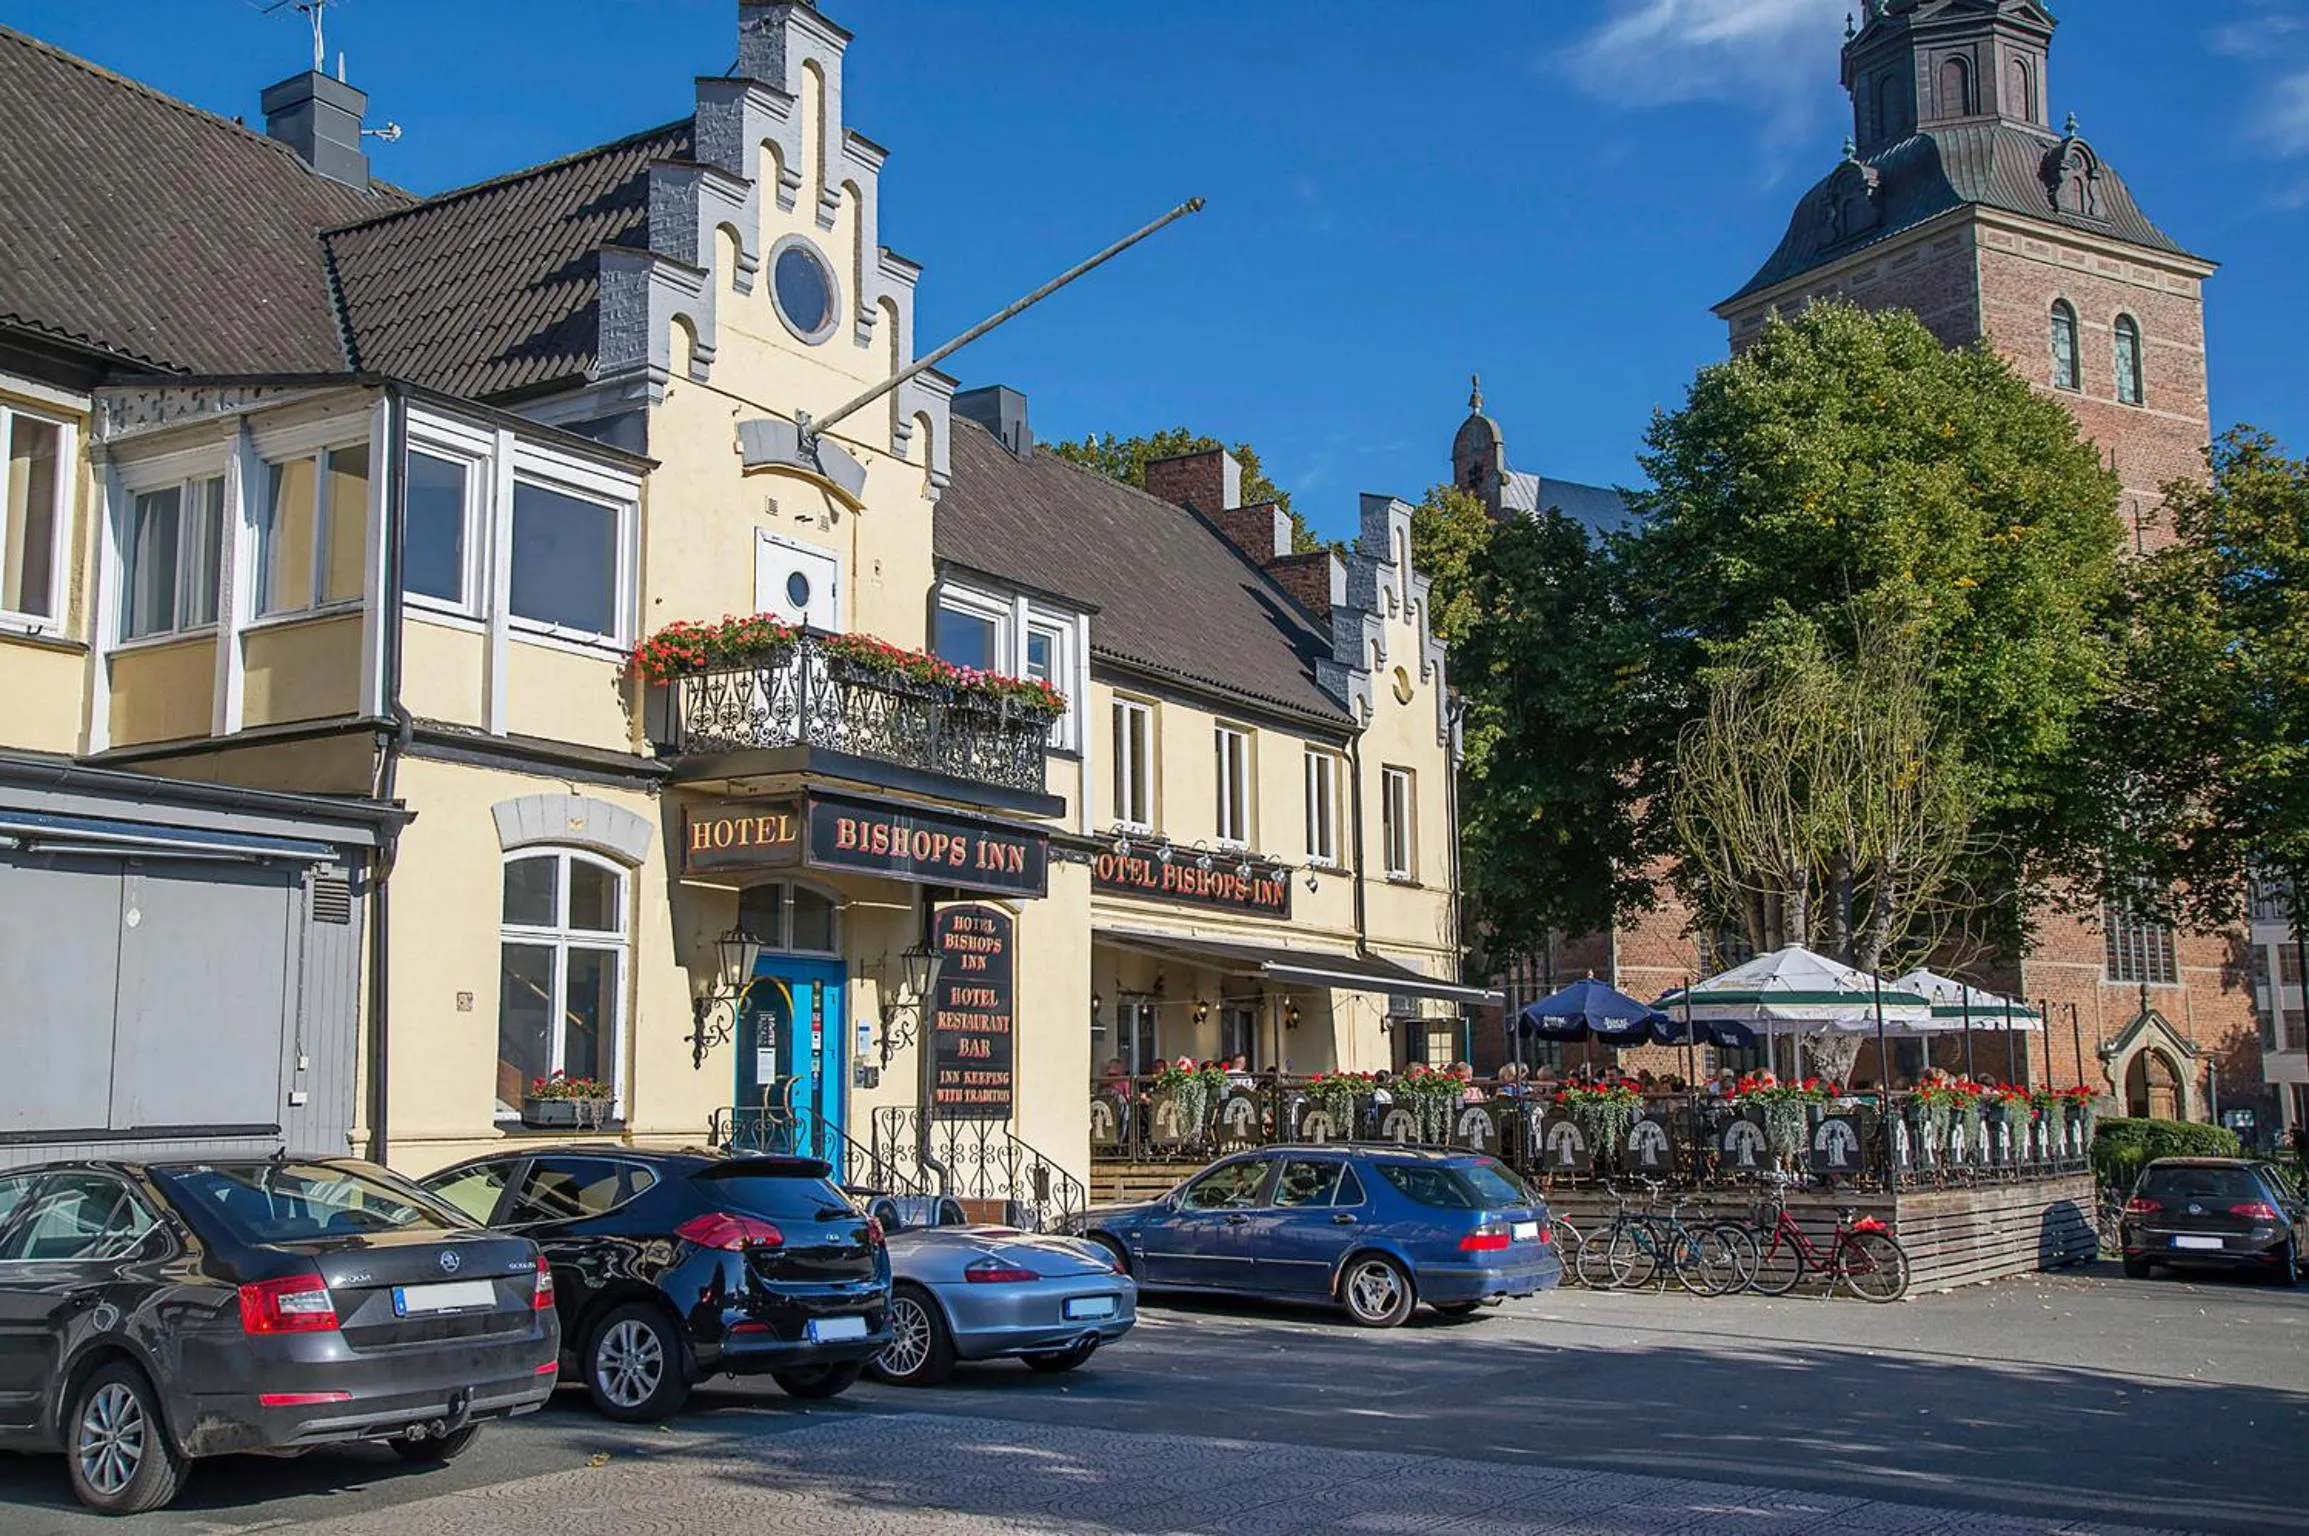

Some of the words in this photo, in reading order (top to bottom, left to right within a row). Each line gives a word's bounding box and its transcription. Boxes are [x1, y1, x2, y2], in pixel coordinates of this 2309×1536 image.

[691, 815, 796, 850] HOTEL
[836, 818, 967, 866] BISHOPS
[976, 839, 1027, 873] INN
[1093, 853, 1157, 888] OTEL
[1161, 862, 1248, 901] BISHOPS
[1253, 878, 1285, 906] INN
[953, 915, 996, 934] HOTEL
[944, 933, 1002, 953] BISHOPS
[960, 954, 987, 970] INN
[950, 987, 999, 1008] HOTEL
[936, 1011, 1010, 1033] RESTAURANT
[958, 1038, 991, 1057] BAR
[940, 1070, 960, 1084] INN
[963, 1071, 1009, 1085] KEEPING
[936, 1089, 962, 1103] WITH
[965, 1089, 1010, 1103] TRADITION
